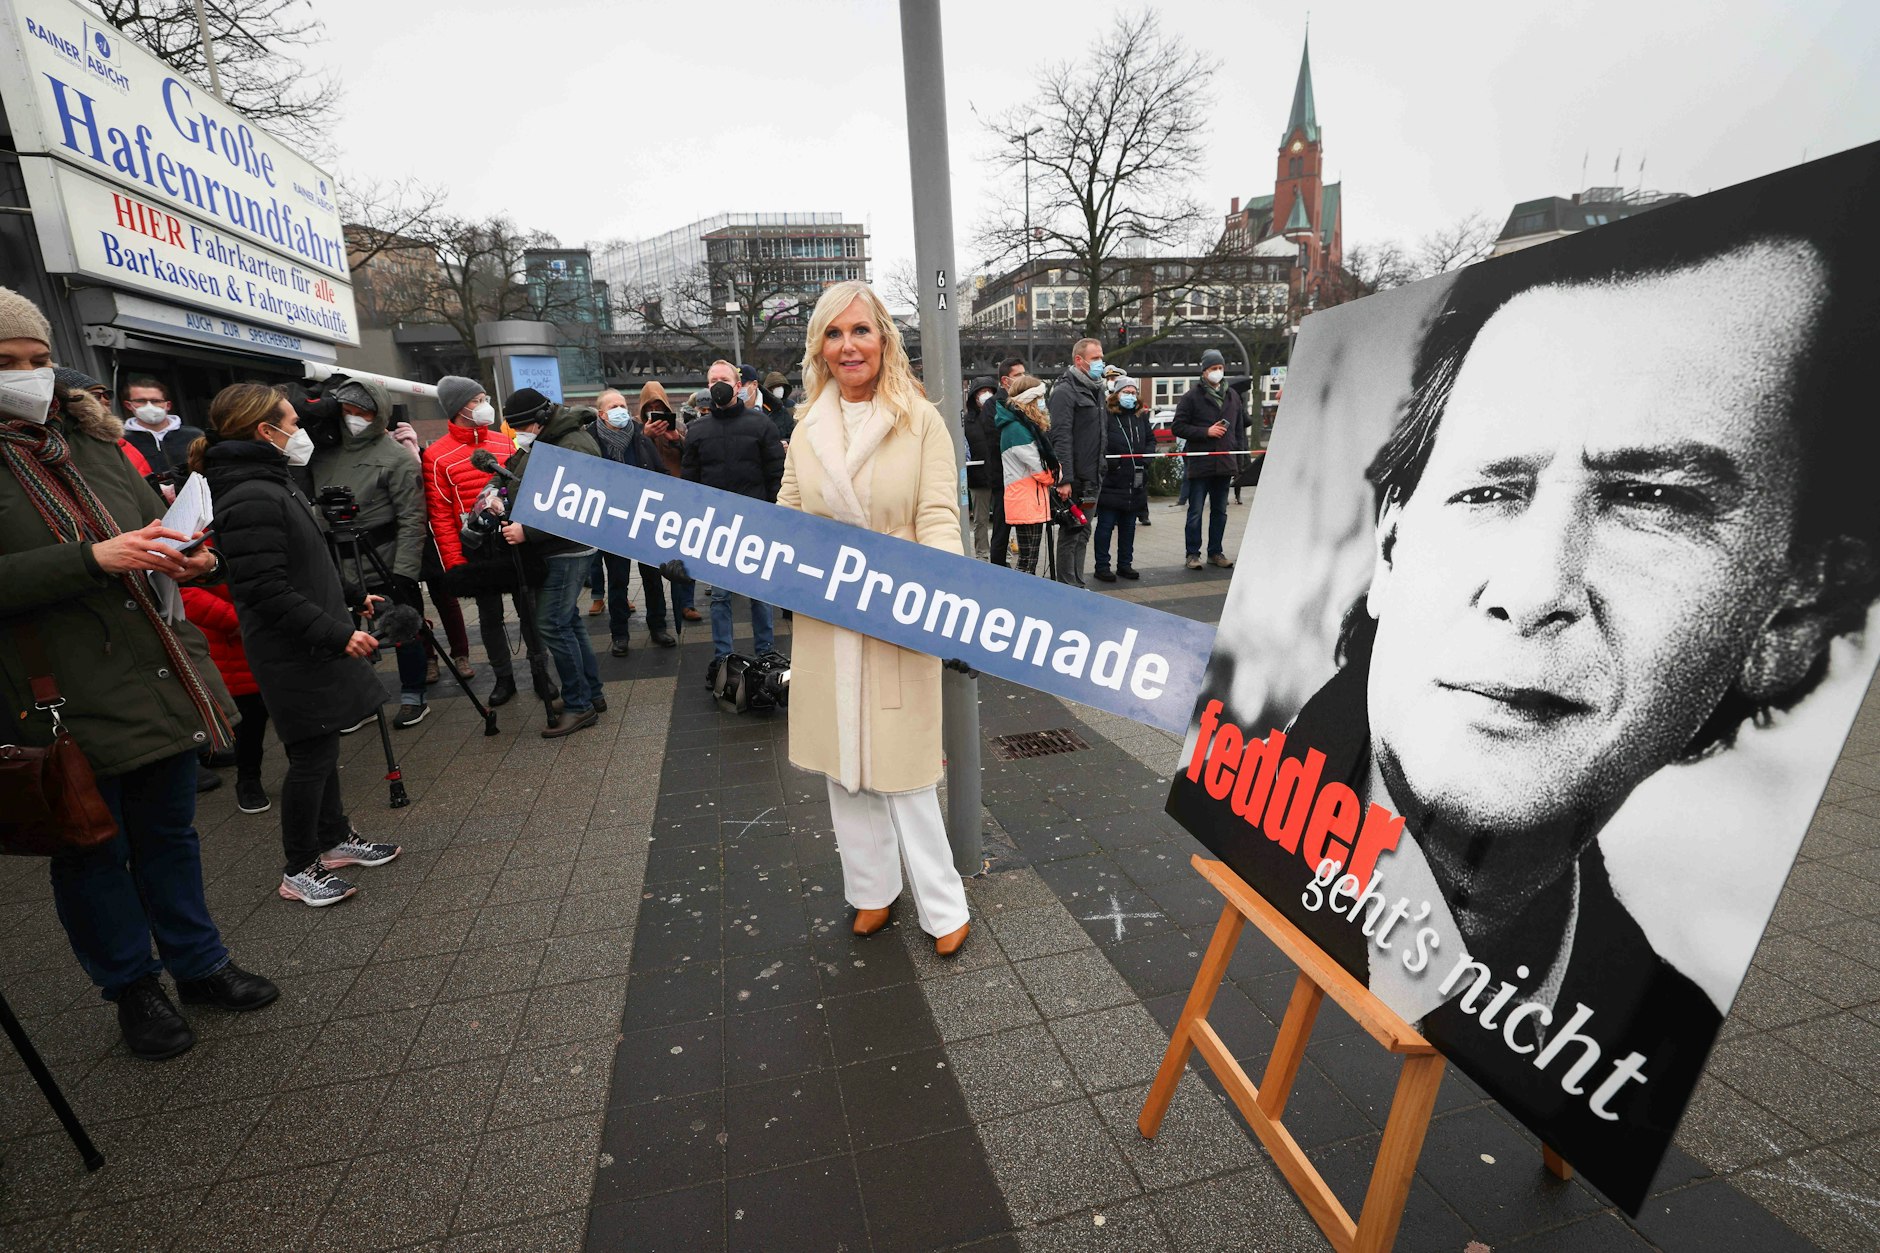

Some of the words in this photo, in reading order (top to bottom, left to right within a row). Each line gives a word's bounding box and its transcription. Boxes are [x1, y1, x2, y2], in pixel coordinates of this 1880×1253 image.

[26, 16, 82, 62] RAINER
[88, 55, 130, 91] ABICHT
[42, 72, 346, 273] Hafenrundfahrt
[162, 77, 277, 189] Große
[98, 229, 222, 297] Barkassen
[227, 274, 243, 304] &
[245, 280, 348, 335] Fahrgastschiffe
[111, 192, 187, 250] HIER
[189, 224, 288, 287] Fahrkarten
[291, 266, 311, 295] für
[314, 279, 335, 304] alle
[938, 271, 945, 287] 6
[938, 293, 947, 310] A
[186, 313, 213, 332] AUCH
[221, 321, 240, 339] ZUR
[249, 328, 303, 351] SPEICHERSTADT
[533, 465, 1170, 700] Jan-Fedder-Promenade
[1186, 698, 1406, 900] fedder
[1301, 857, 1440, 973] geht's
[1437, 951, 1649, 1121] nicht
